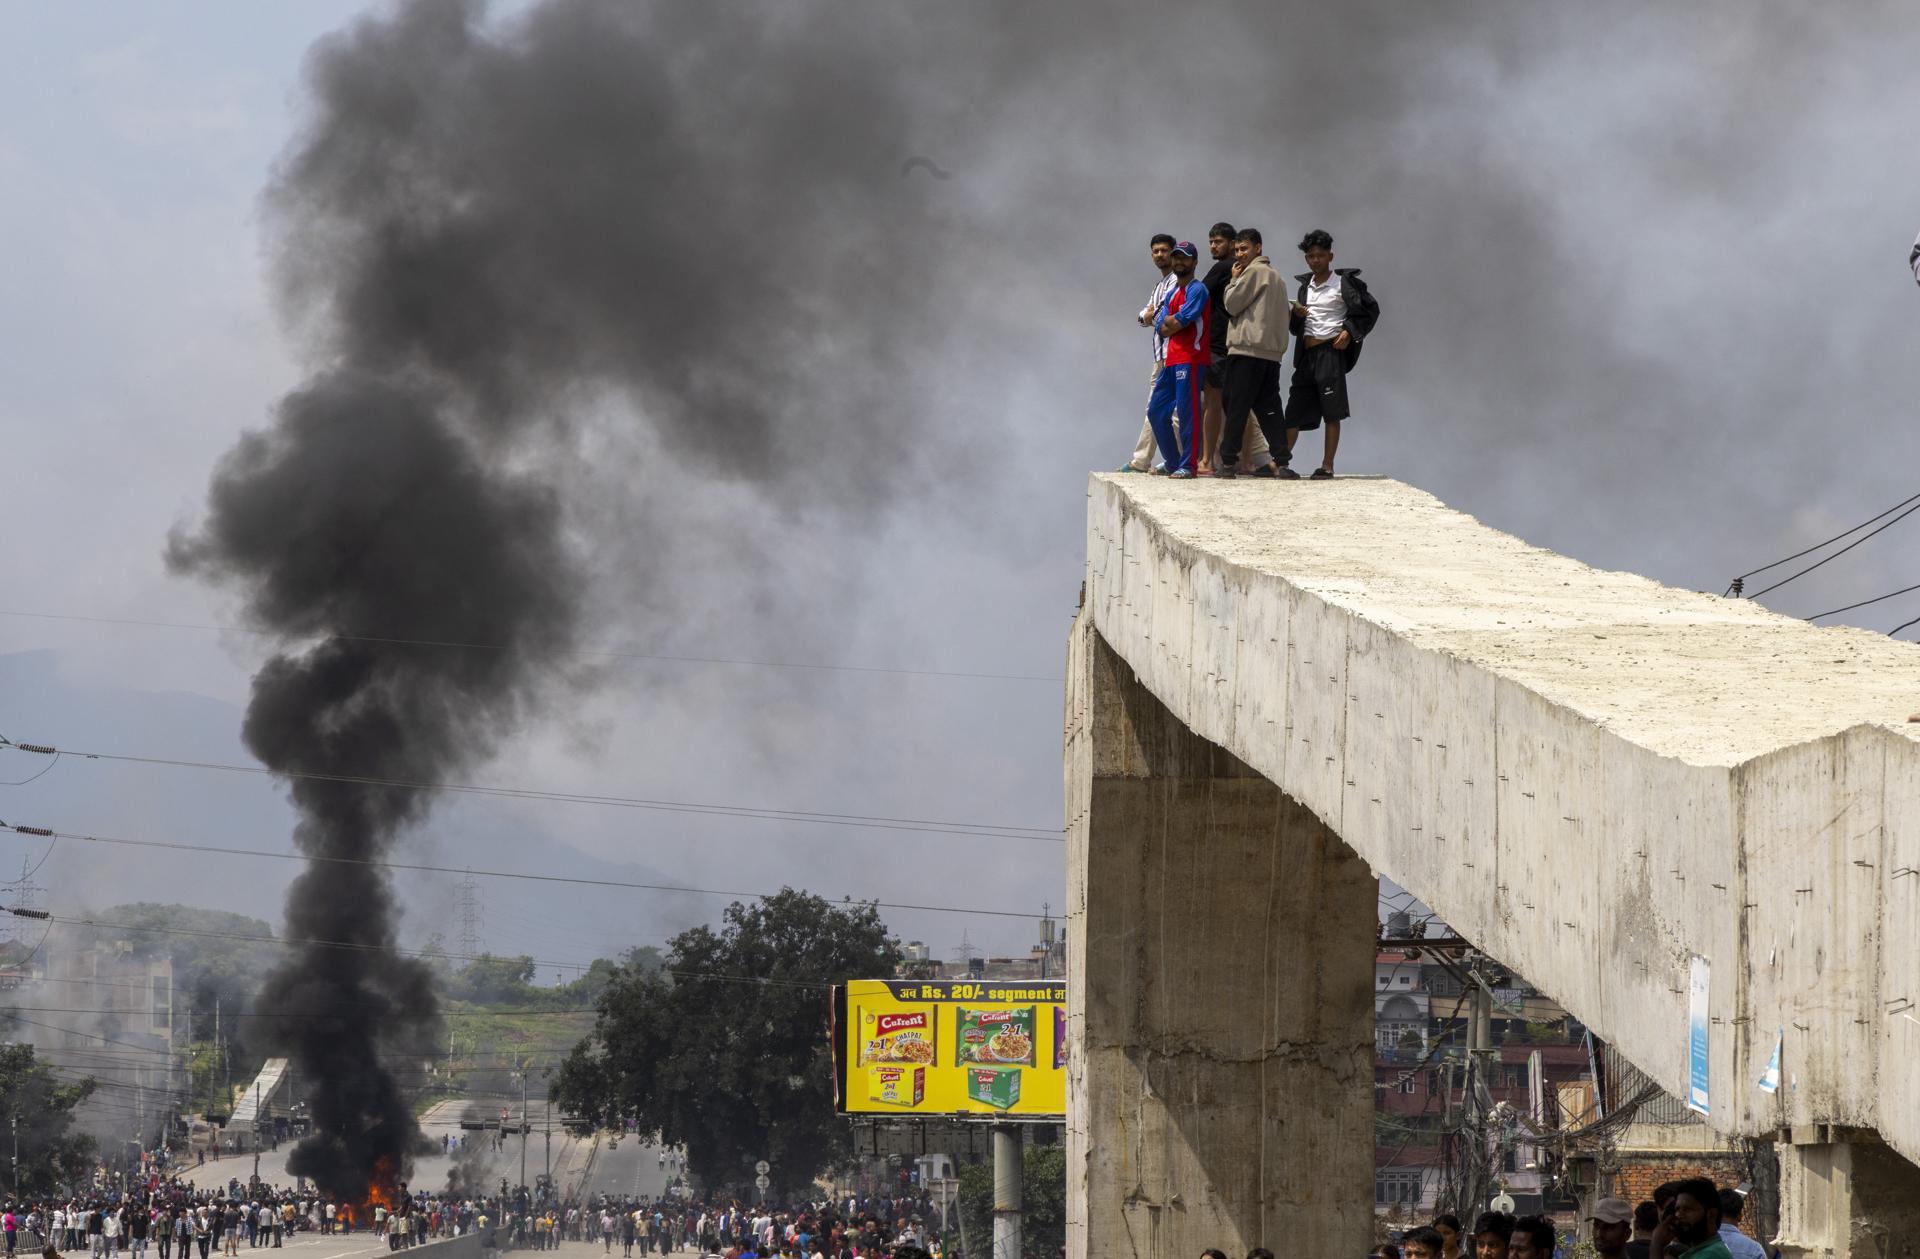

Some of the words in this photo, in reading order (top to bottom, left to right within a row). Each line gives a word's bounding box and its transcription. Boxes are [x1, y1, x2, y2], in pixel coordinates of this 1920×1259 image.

[922, 985, 946, 999] Rs.
[951, 984, 985, 999] 20/-
[988, 988, 1051, 1002] segment
[881, 1015, 923, 1029] Current
